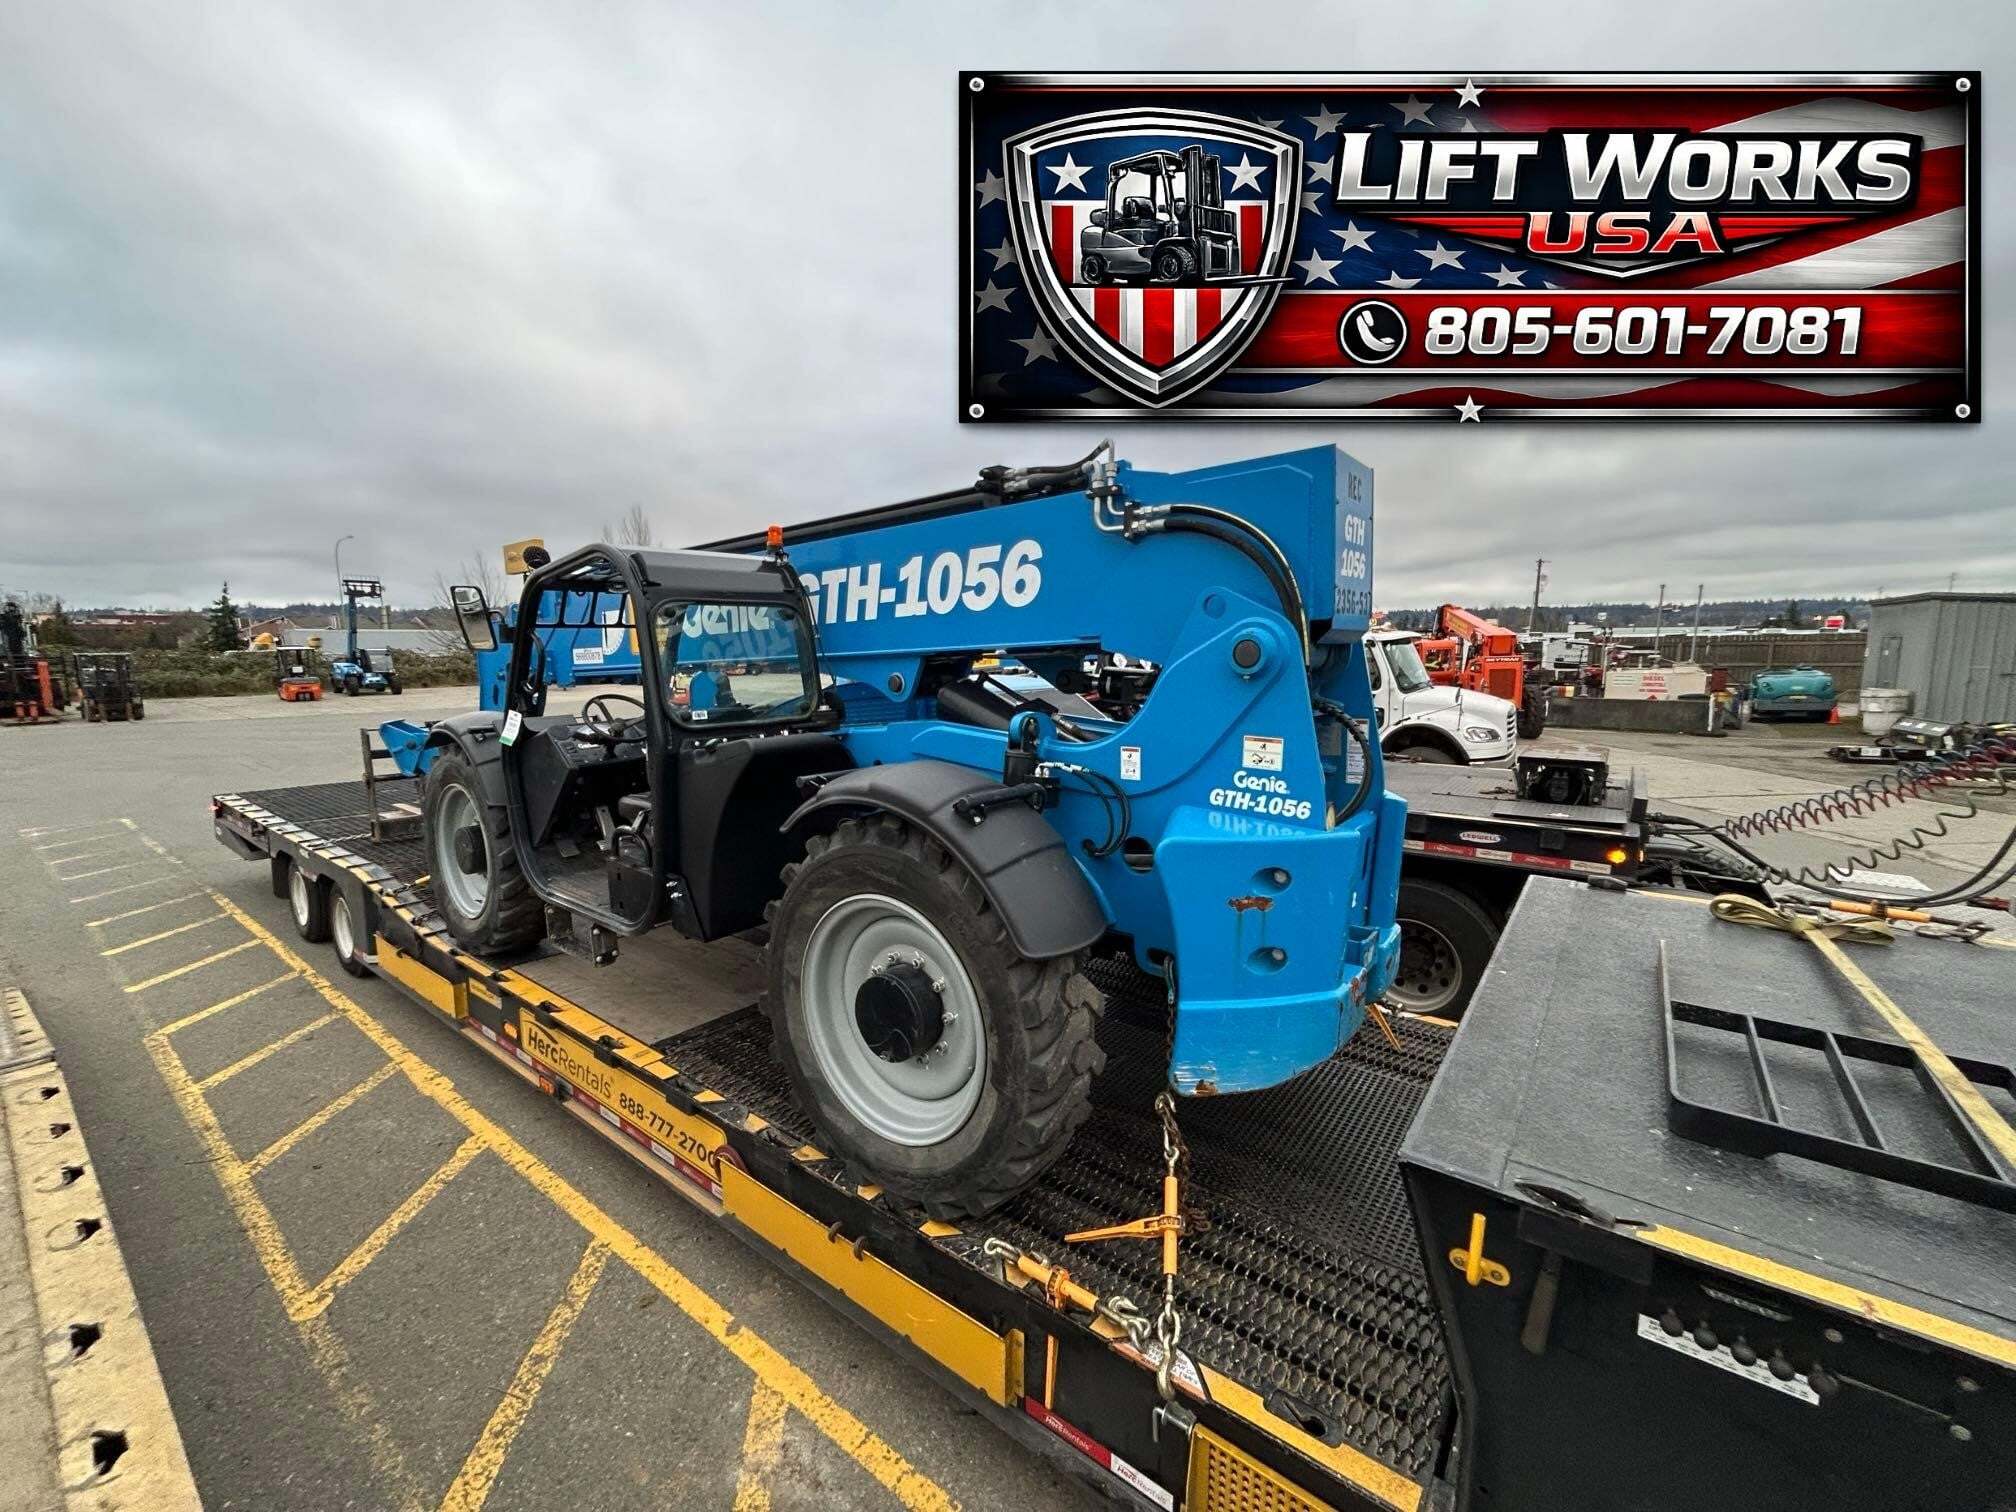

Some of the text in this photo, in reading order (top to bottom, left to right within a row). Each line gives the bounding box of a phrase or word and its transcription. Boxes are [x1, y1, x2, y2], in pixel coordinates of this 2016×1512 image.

[1344, 514, 1365, 546] GTH
[1340, 548, 1367, 580] 1056
[799, 539, 1043, 625] GTH-1056
[682, 605, 769, 638] Genie
[1233, 770, 1288, 795] Genie
[1209, 788, 1312, 820] GTH-1056
[1461, 831, 1498, 842] LEDWELL
[527, 1027, 613, 1100] HercRentals
